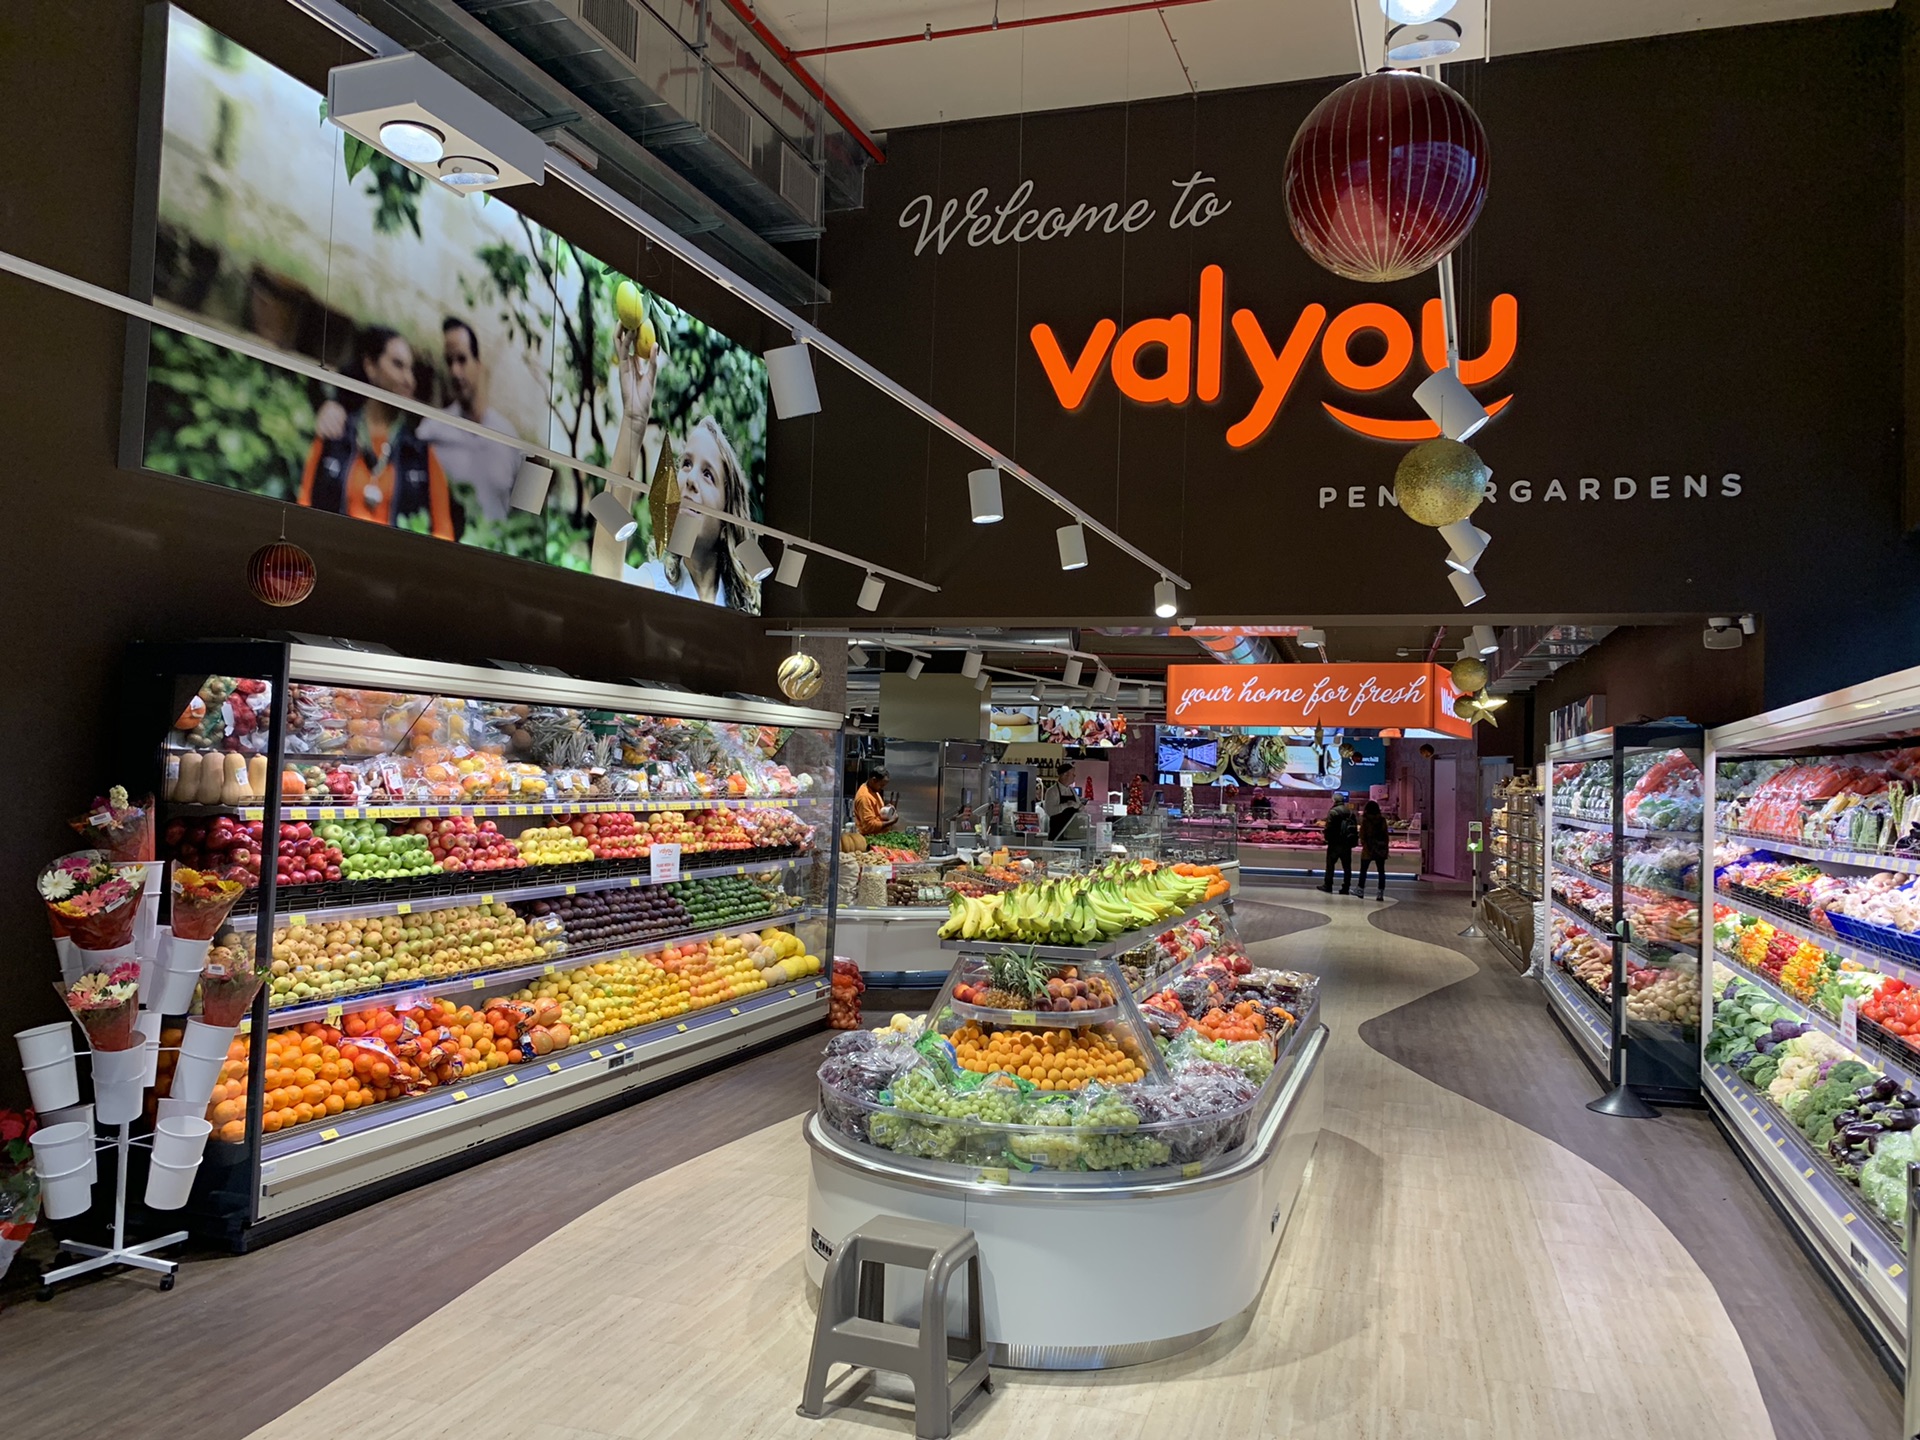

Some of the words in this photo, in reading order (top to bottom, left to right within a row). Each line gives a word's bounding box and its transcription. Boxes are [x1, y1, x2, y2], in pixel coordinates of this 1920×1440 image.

[899, 179, 1157, 257] Welcome
[1167, 170, 1232, 230] to
[1030, 264, 1518, 449] valyou
[1318, 473, 1742, 509] PENRGARDENS
[1174, 685, 1235, 715] your
[1237, 675, 1306, 703] home
[1302, 676, 1352, 716] for
[1348, 675, 1428, 716] fresh
